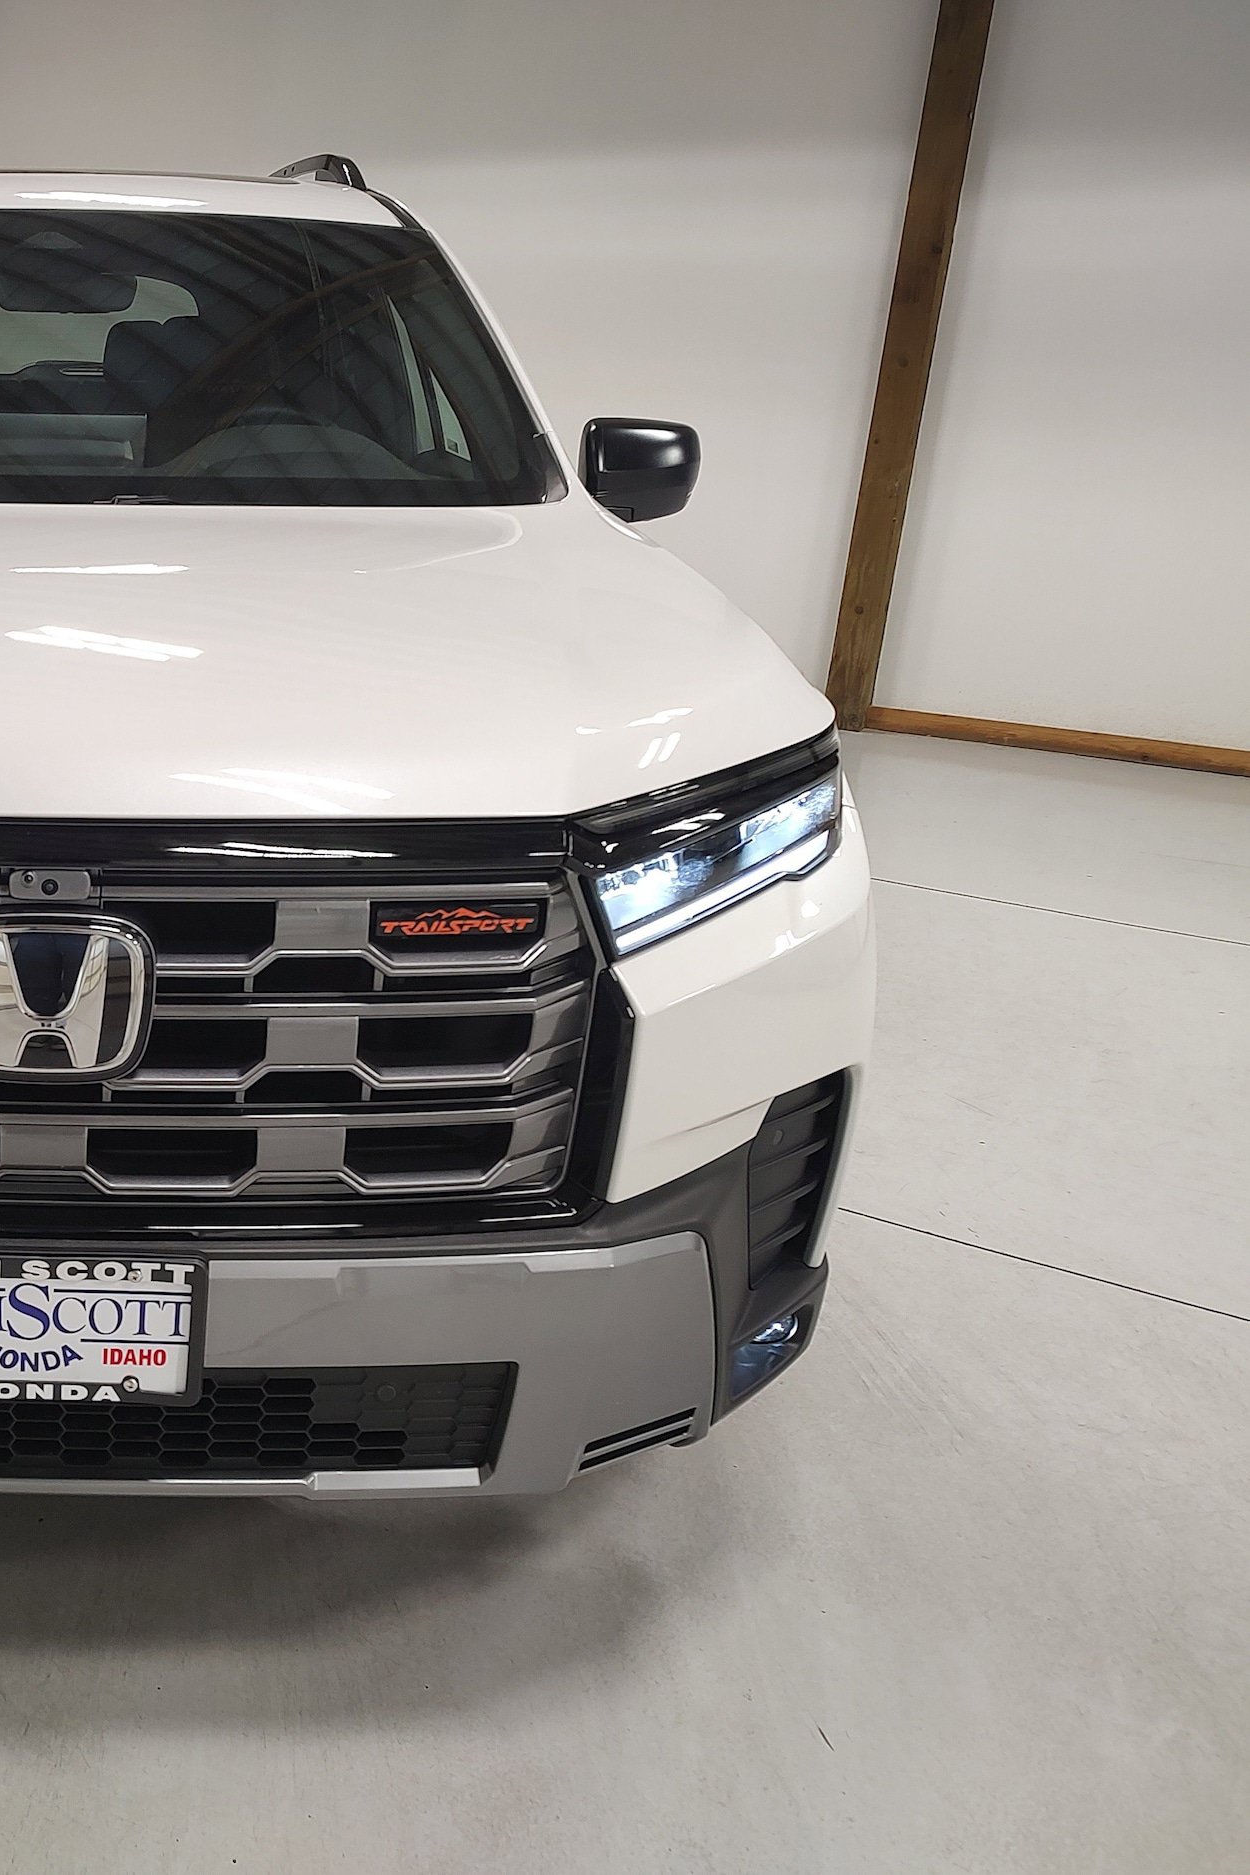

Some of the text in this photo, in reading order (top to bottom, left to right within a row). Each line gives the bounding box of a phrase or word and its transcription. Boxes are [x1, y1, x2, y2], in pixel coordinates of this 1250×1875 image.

[380, 918, 535, 936] TRAILSPORT
[21, 1260, 195, 1285] SCOTT
[102, 1348, 167, 1367] IDAHO
